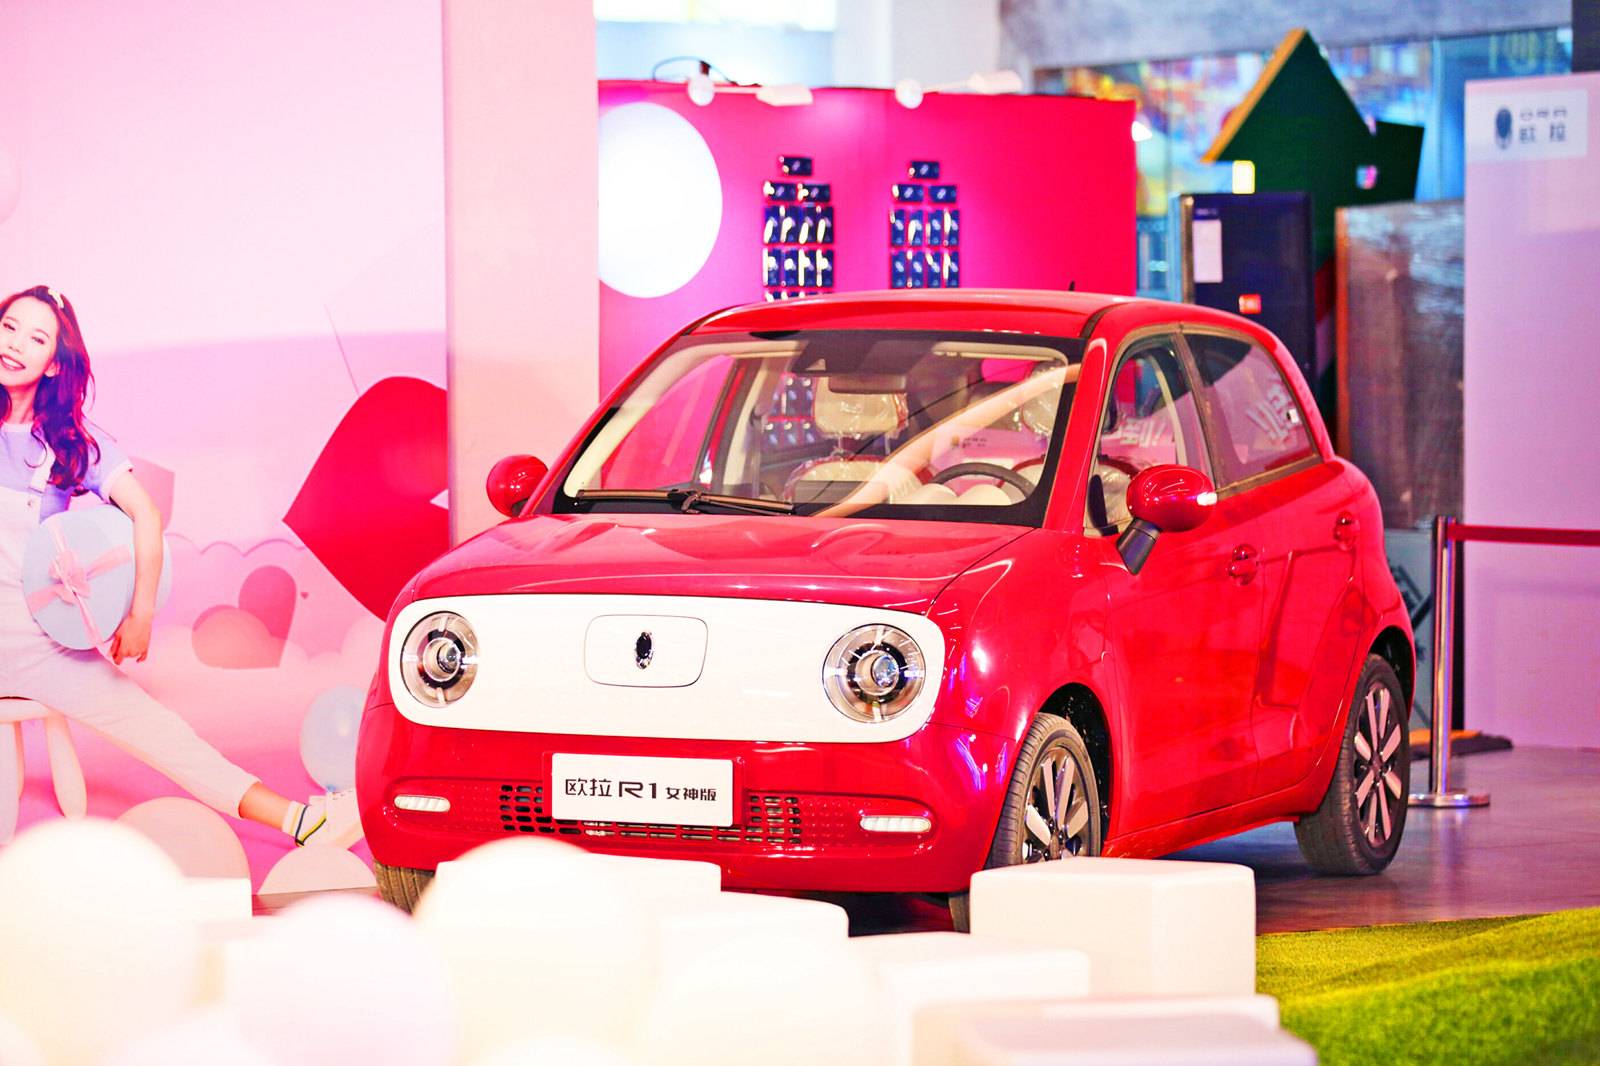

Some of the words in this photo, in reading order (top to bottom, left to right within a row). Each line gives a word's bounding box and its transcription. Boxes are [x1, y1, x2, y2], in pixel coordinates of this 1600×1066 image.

[565, 778, 612, 797] 欧拉
[618, 781, 657, 799] R1
[665, 787, 717, 801] 女神版
